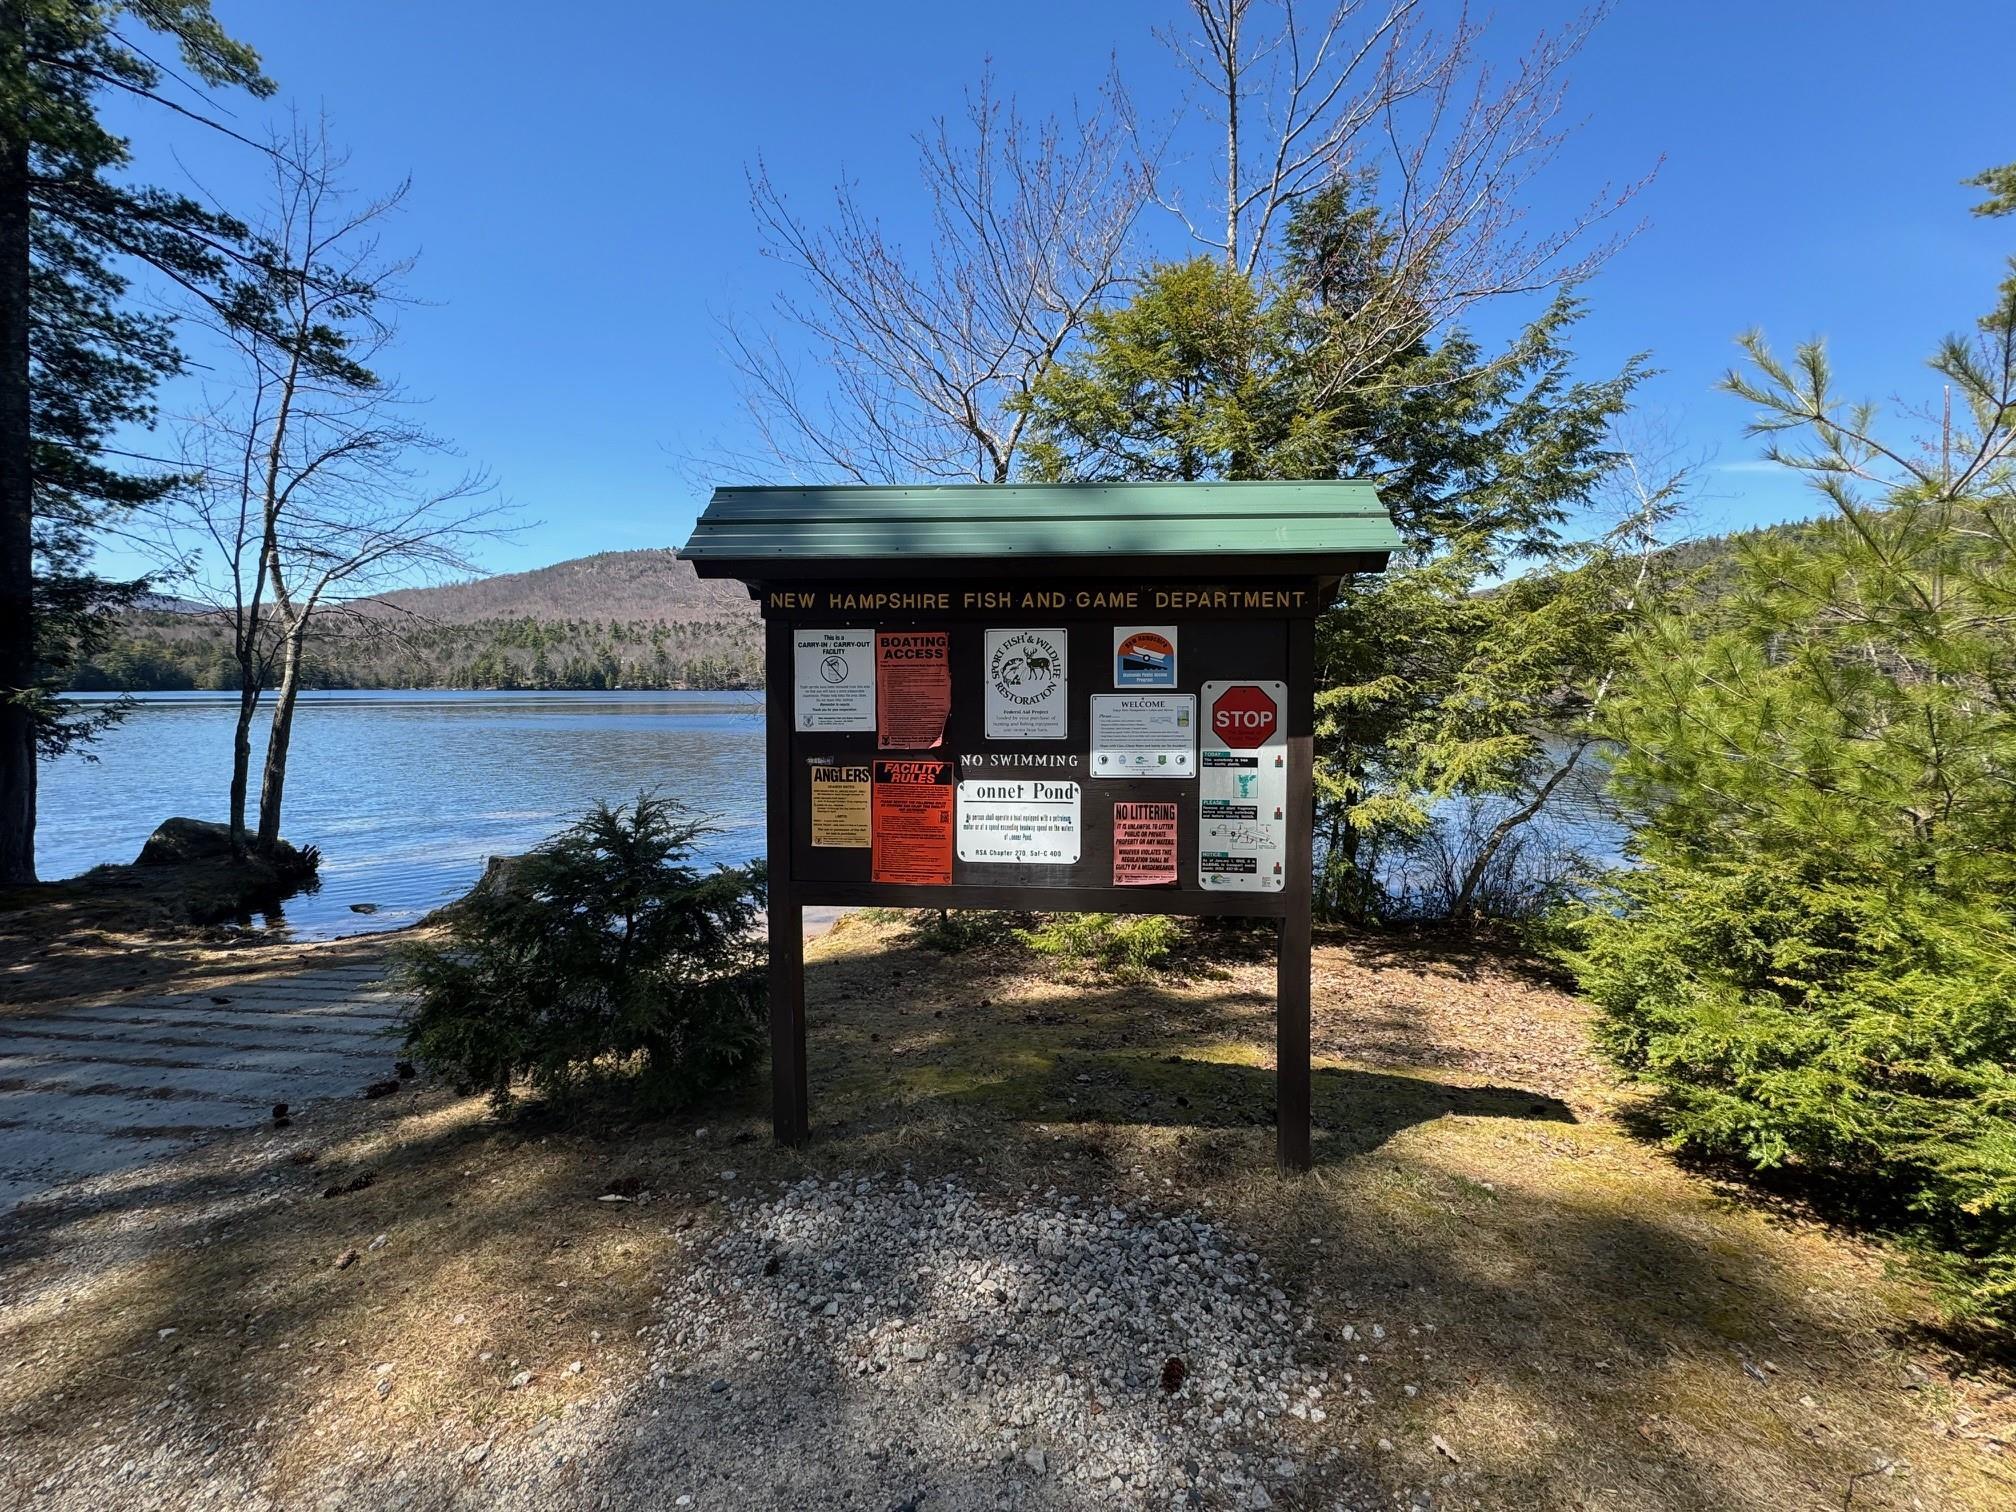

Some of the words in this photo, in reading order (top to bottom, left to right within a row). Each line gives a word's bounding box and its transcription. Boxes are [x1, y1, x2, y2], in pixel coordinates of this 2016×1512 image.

[770, 592, 816, 608] NEW
[830, 592, 950, 609] HAMPSHIRE
[964, 592, 1011, 608] FISH
[1022, 592, 1065, 608] AND
[1076, 592, 1138, 608] GAME
[1156, 591, 1305, 608] DEPARTMENT
[880, 636, 946, 647] BOATING
[884, 649, 943, 659] ACCESS
[991, 648, 1004, 680] SPORT
[1002, 634, 1025, 650] FISH
[1027, 635, 1034, 643] &
[1036, 637, 1061, 679] WILDLIFE
[995, 681, 1056, 705] RESTORATION
[1216, 710, 1273, 727] STOP
[961, 754, 983, 766] NO
[990, 754, 1078, 767] SWIMMING
[814, 768, 871, 782] ANGLERS
[884, 763, 944, 774] FACILITY
[890, 773, 936, 784] RULES
[1034, 783, 1074, 799] Pond
[1116, 805, 1127, 820] NO
[1130, 805, 1174, 820] LITTERING
